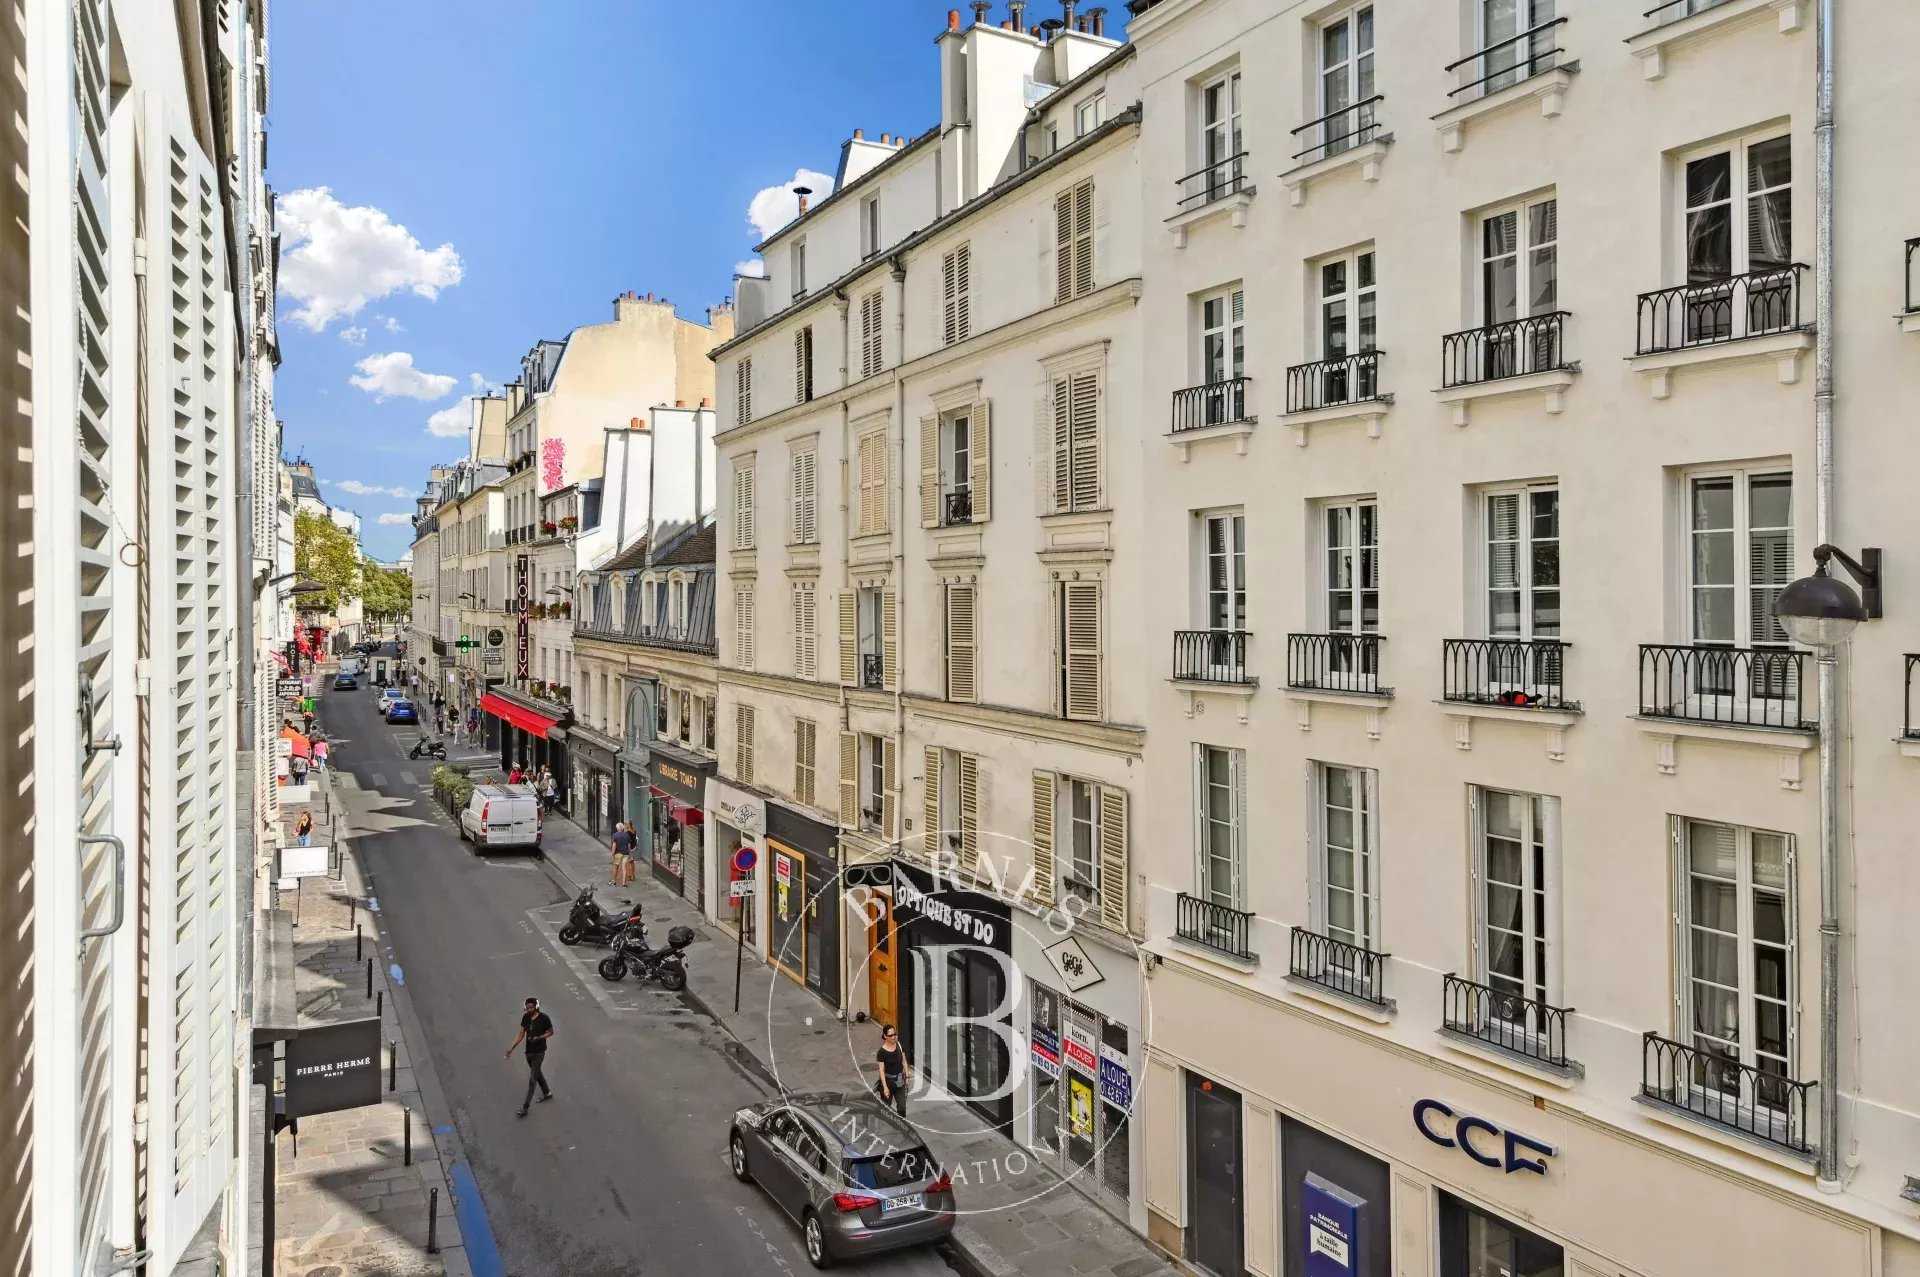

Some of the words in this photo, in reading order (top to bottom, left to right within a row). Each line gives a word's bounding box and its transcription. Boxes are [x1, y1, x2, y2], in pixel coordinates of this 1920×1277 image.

[518, 557, 528, 677] THOUMIEUX
[896, 885, 951, 926] OPTIQUE
[953, 909, 972, 935] ST
[973, 918, 994, 945] DO
[296, 1062, 333, 1077] PIERRE
[336, 1056, 371, 1070] HERMÉ
[1073, 1048, 1095, 1067] LOUER
[1413, 1098, 1556, 1176] CCF
[1316, 1237, 1342, 1257] humaine
[1324, 1235, 1339, 1248] taille
